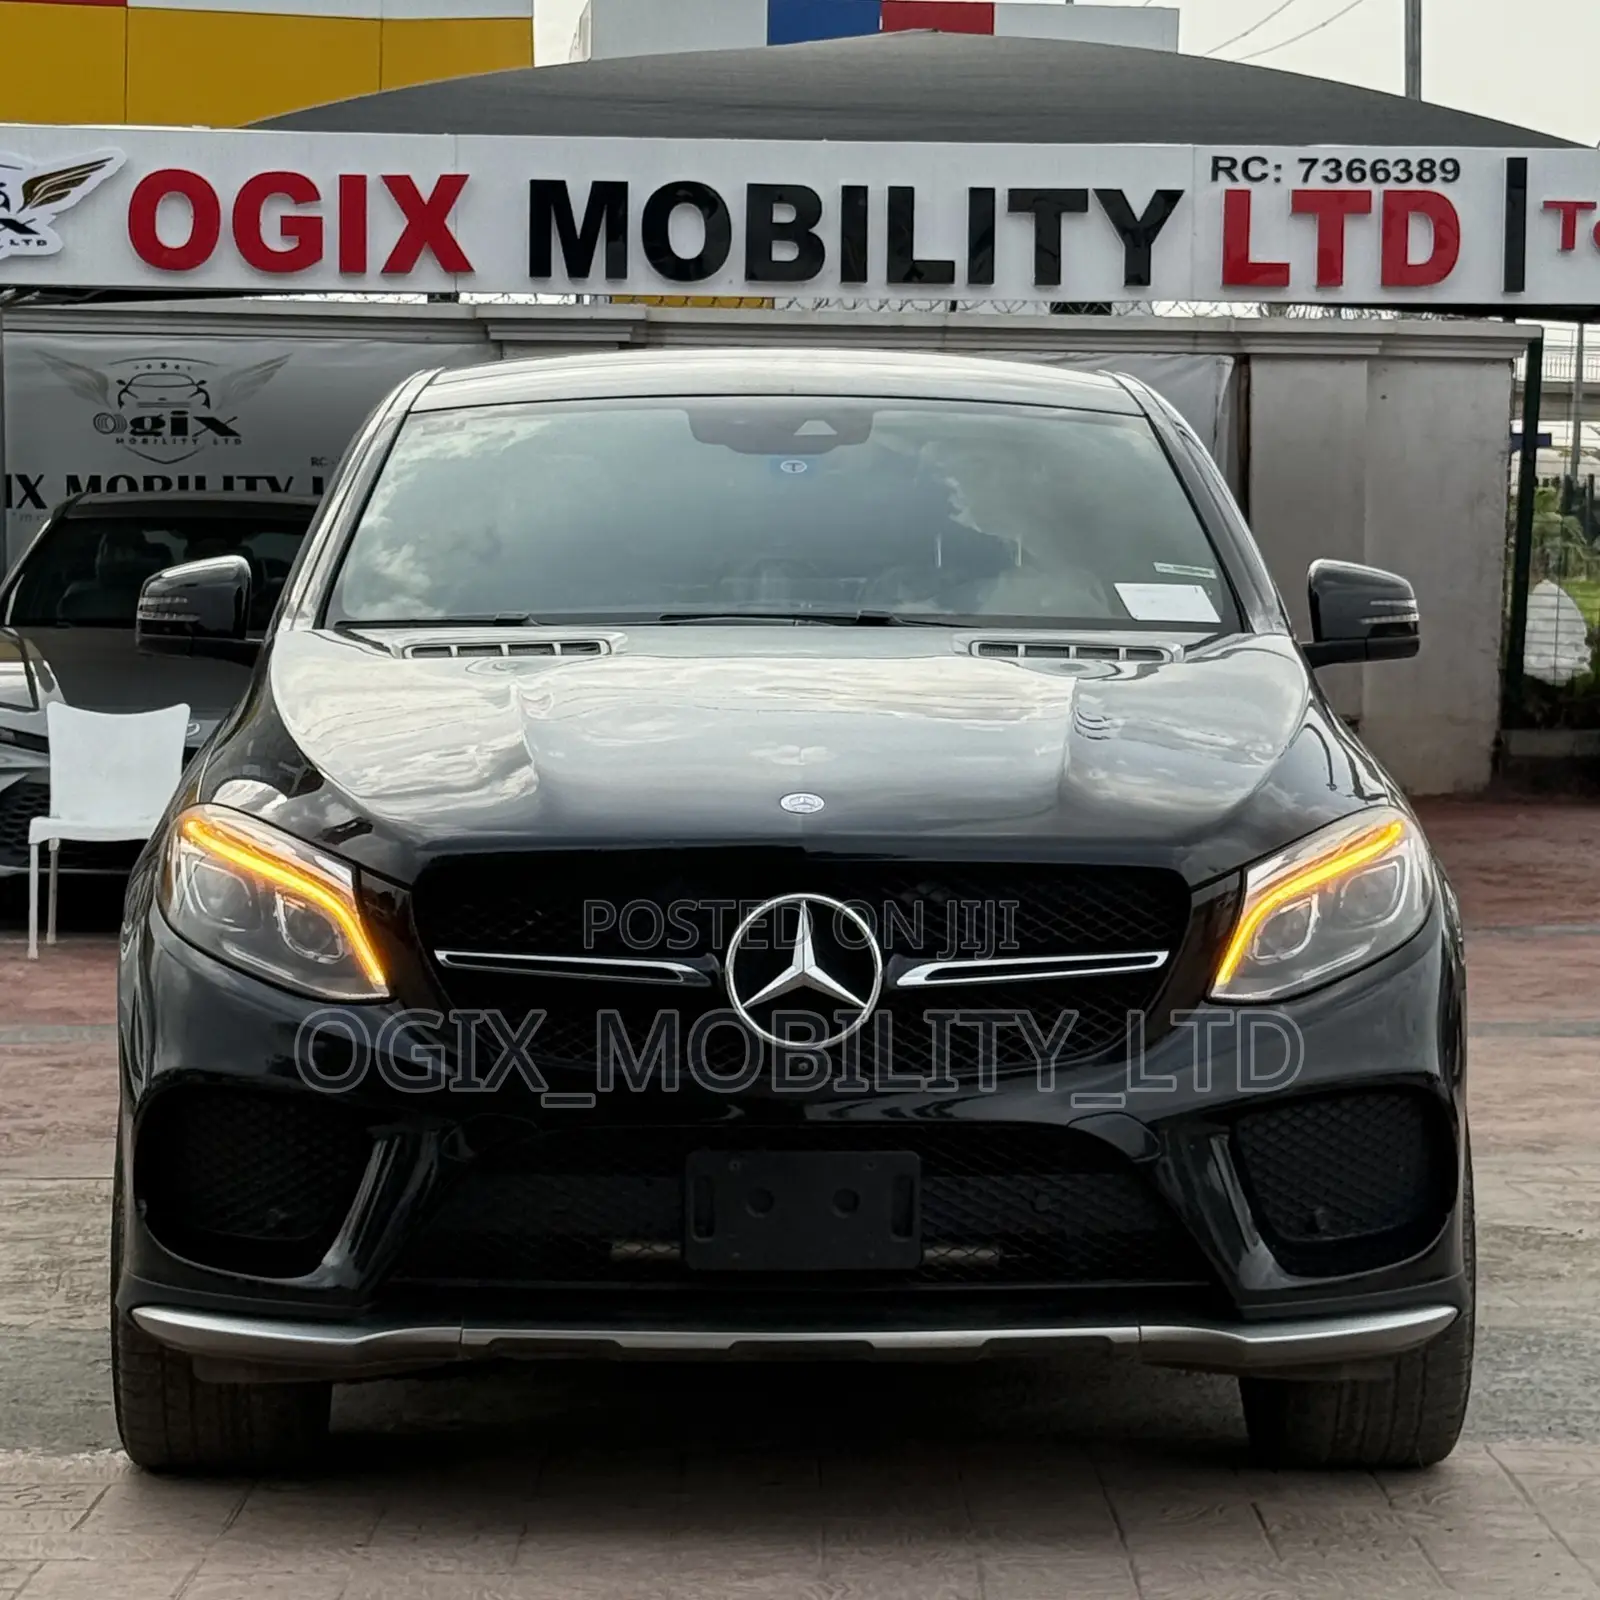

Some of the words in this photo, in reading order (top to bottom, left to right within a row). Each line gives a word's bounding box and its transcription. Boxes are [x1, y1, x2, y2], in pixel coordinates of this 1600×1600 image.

[1210, 156, 1282, 183] RC:
[1298, 158, 1461, 183] 7366389
[128, 168, 475, 274] OGIX
[529, 180, 1185, 286] MOBILITY
[1221, 188, 1461, 287] LTD
